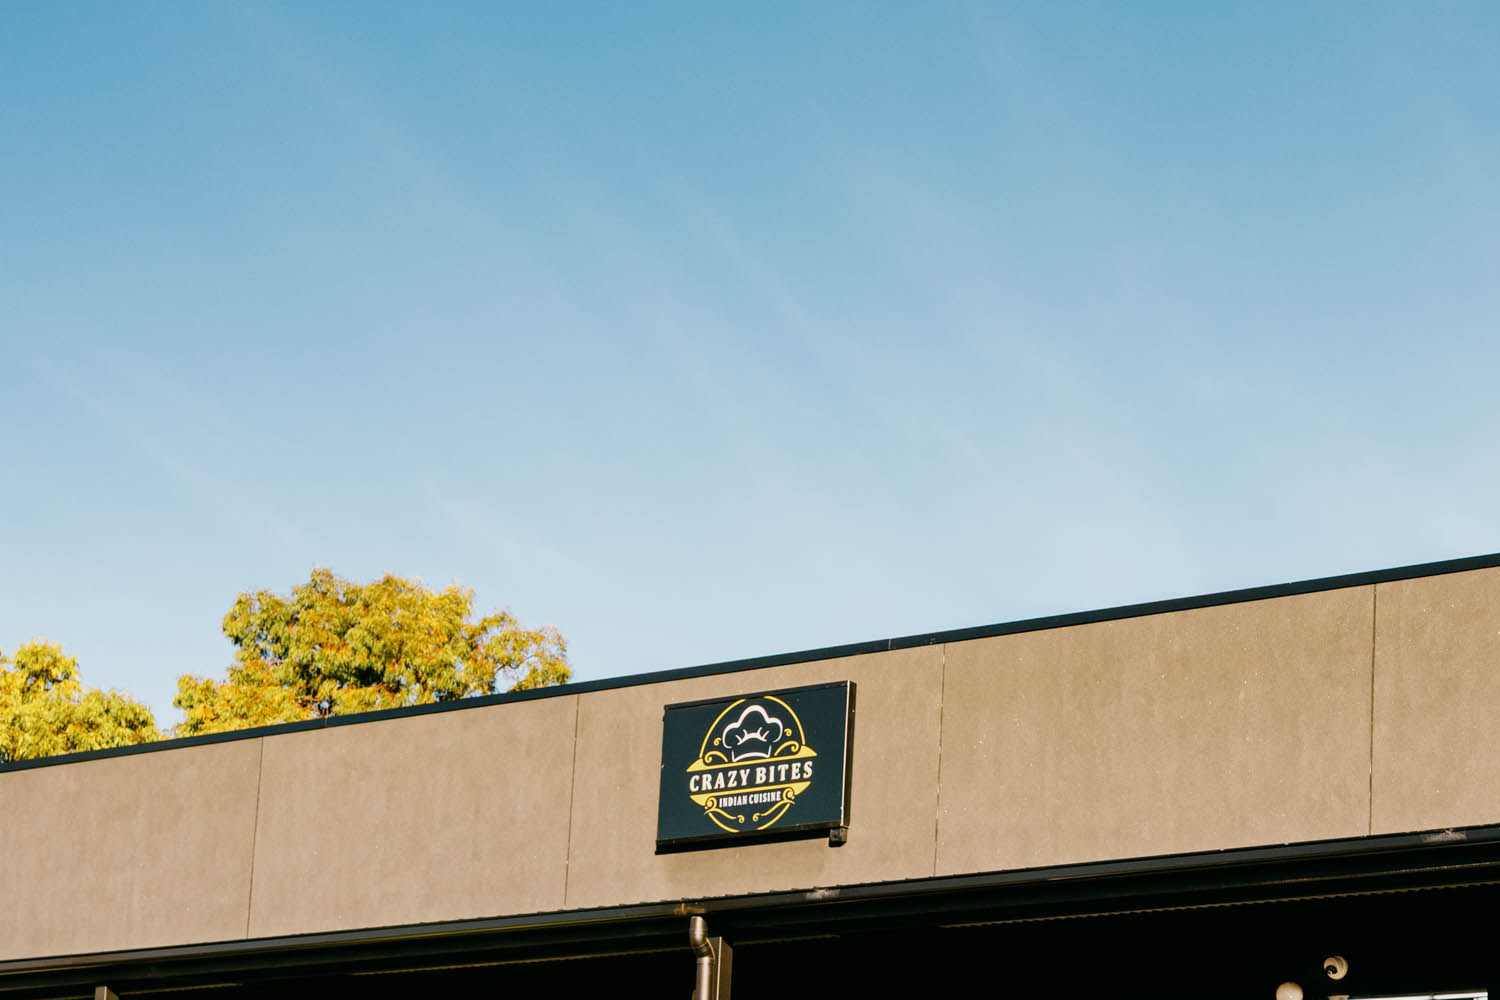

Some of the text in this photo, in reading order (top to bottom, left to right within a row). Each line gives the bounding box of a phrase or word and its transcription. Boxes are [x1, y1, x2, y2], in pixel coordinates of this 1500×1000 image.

[689, 761, 813, 792] CRAZY BITES
[719, 790, 781, 808] INDIAN CUISINE
